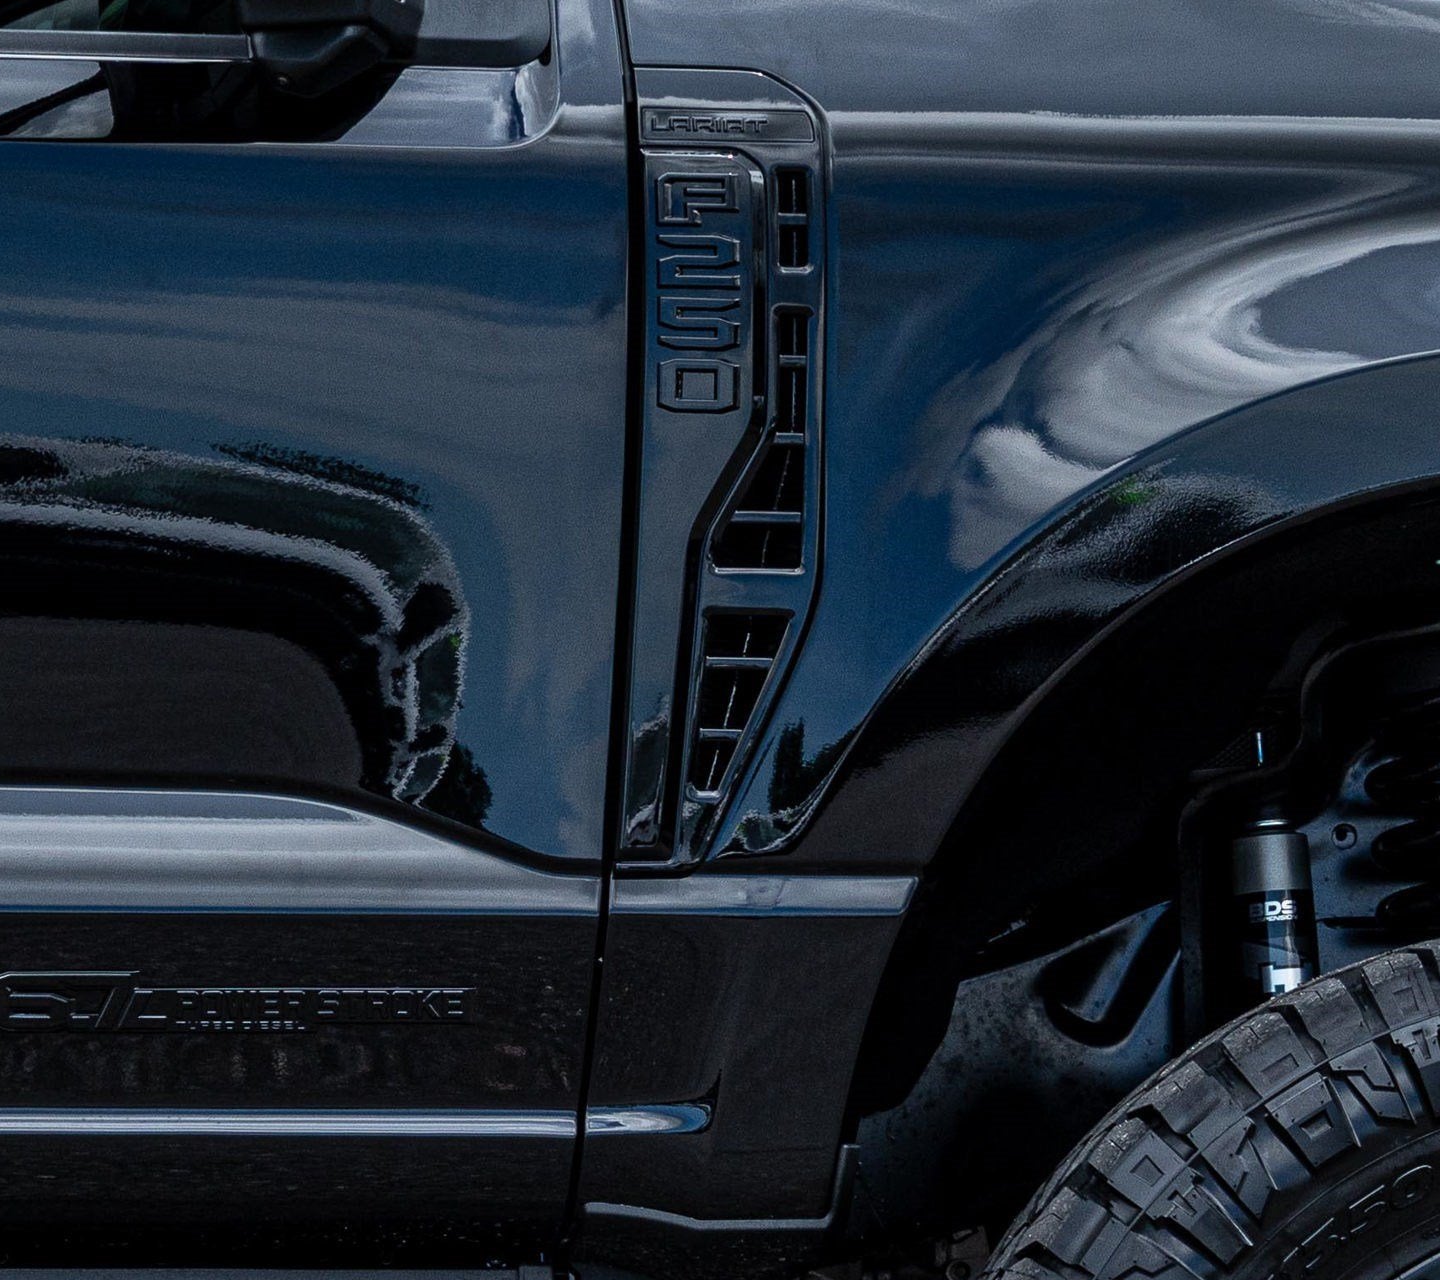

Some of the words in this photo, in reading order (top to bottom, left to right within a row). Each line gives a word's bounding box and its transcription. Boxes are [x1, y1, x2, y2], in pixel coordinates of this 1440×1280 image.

[650, 114, 768, 134] LARIAT
[656, 171, 742, 415] F250
[175, 989, 307, 1018] POWER
[317, 989, 465, 1018] STROKE
